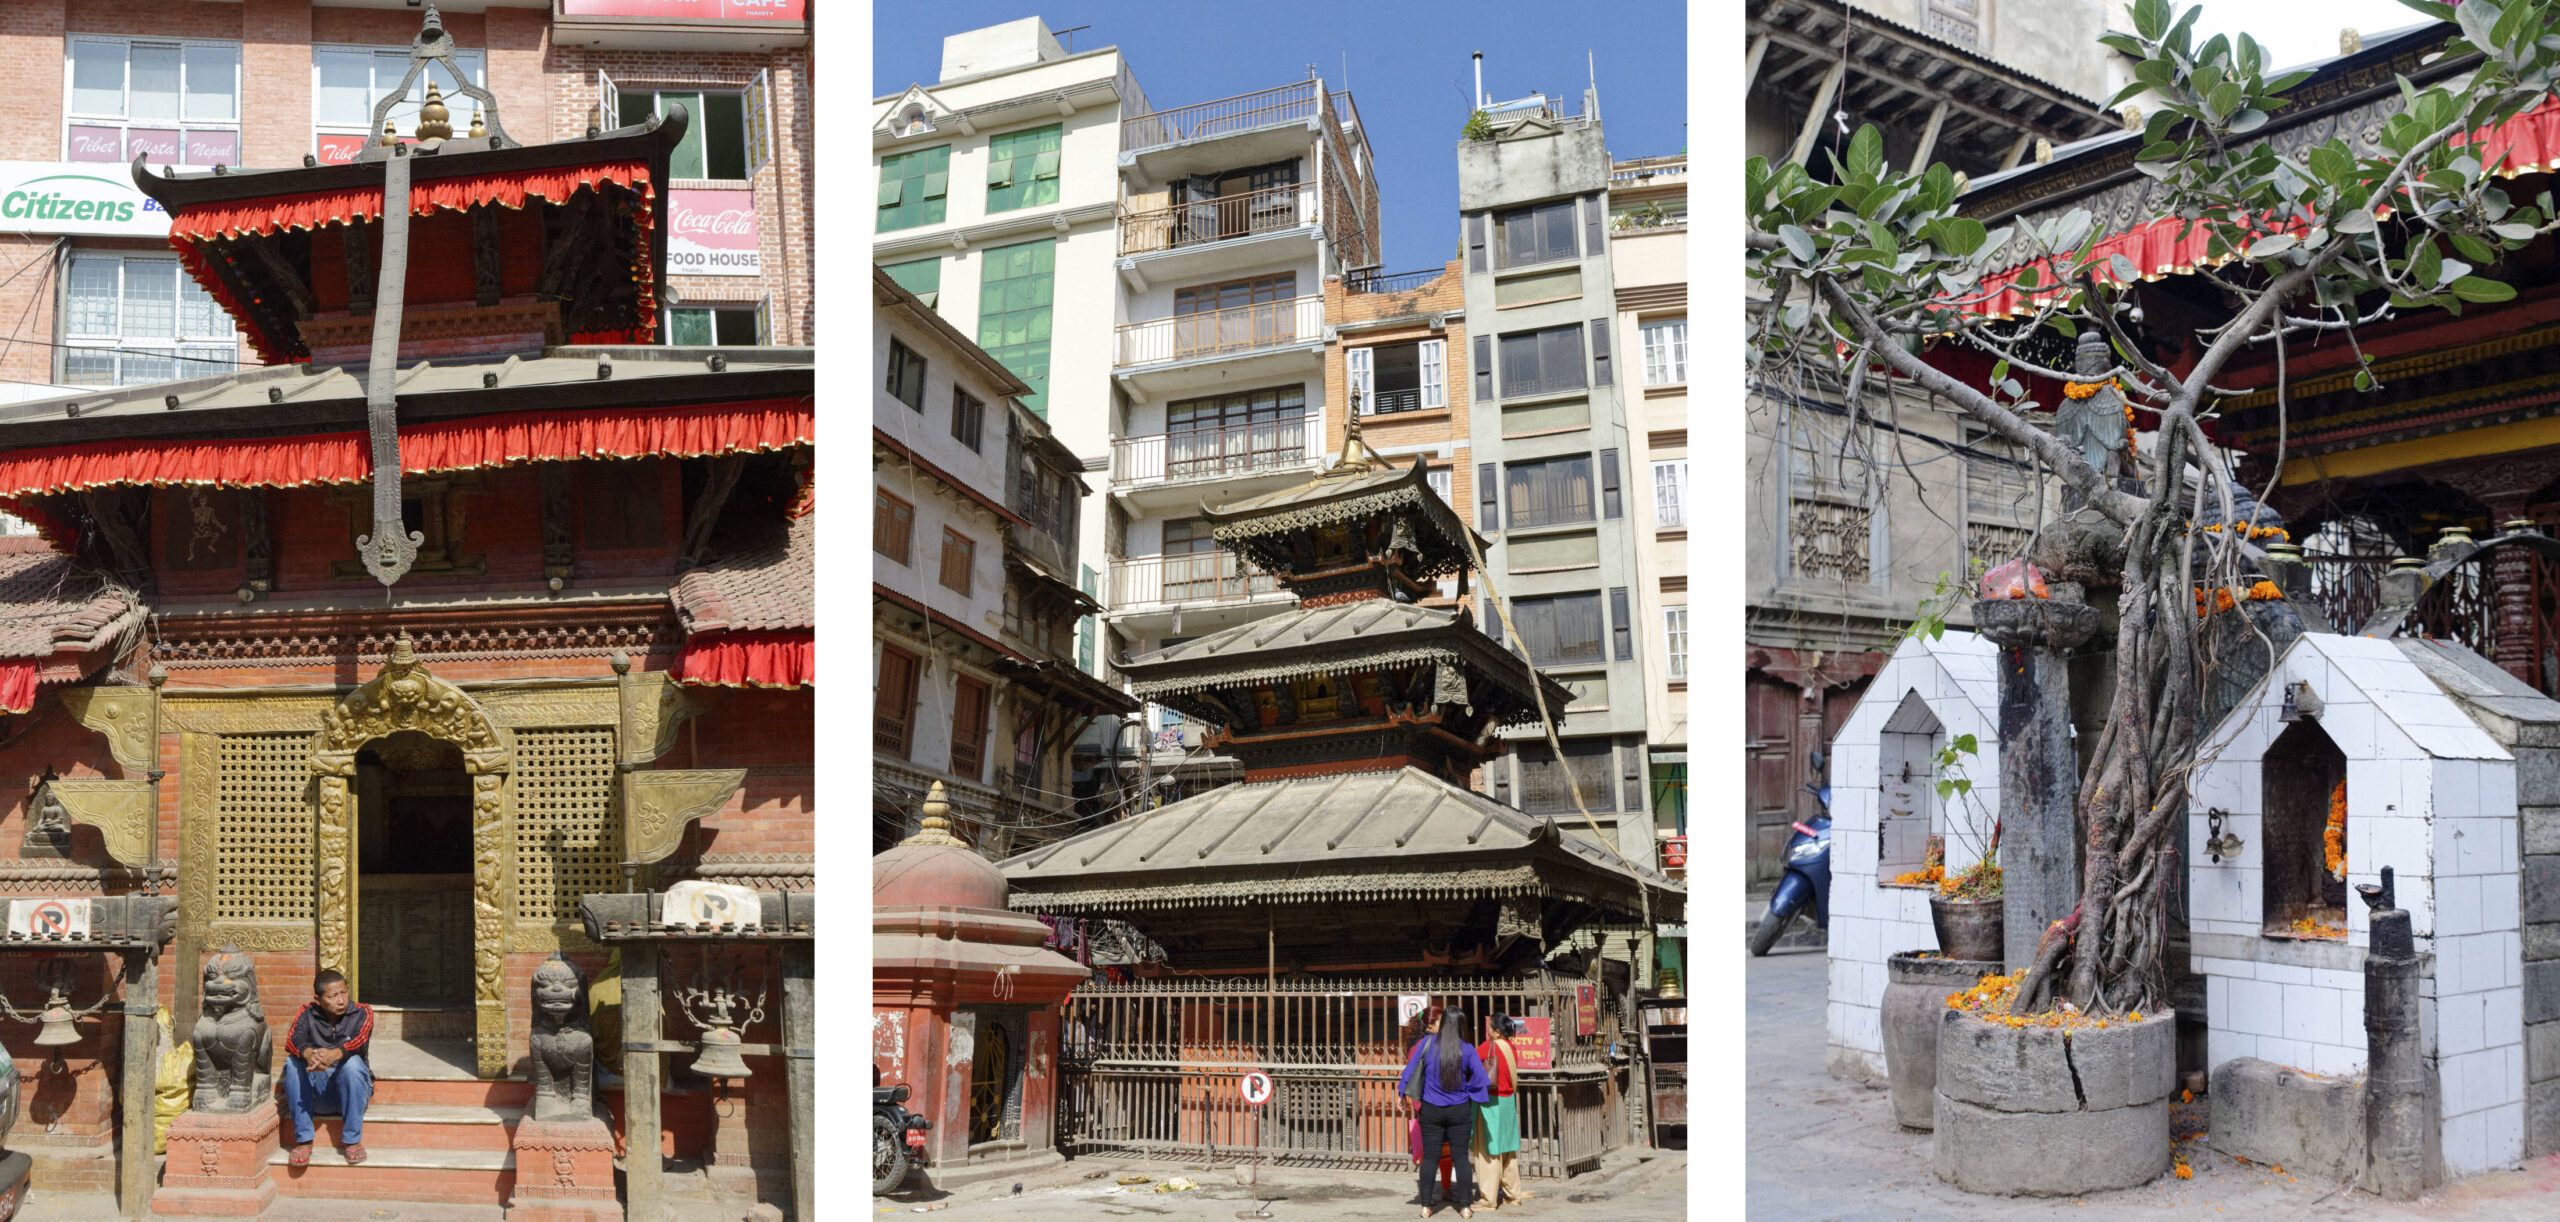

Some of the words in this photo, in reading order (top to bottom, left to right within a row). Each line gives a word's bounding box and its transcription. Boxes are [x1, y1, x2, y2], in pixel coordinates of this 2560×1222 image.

[75, 135, 117, 154] Tibet
[131, 138, 176, 156] Vista
[191, 141, 233, 158] Nepal
[322, 144, 362, 161] Tibe
[2, 191, 135, 222] Citizens
[709, 253, 759, 267] HOUSE
